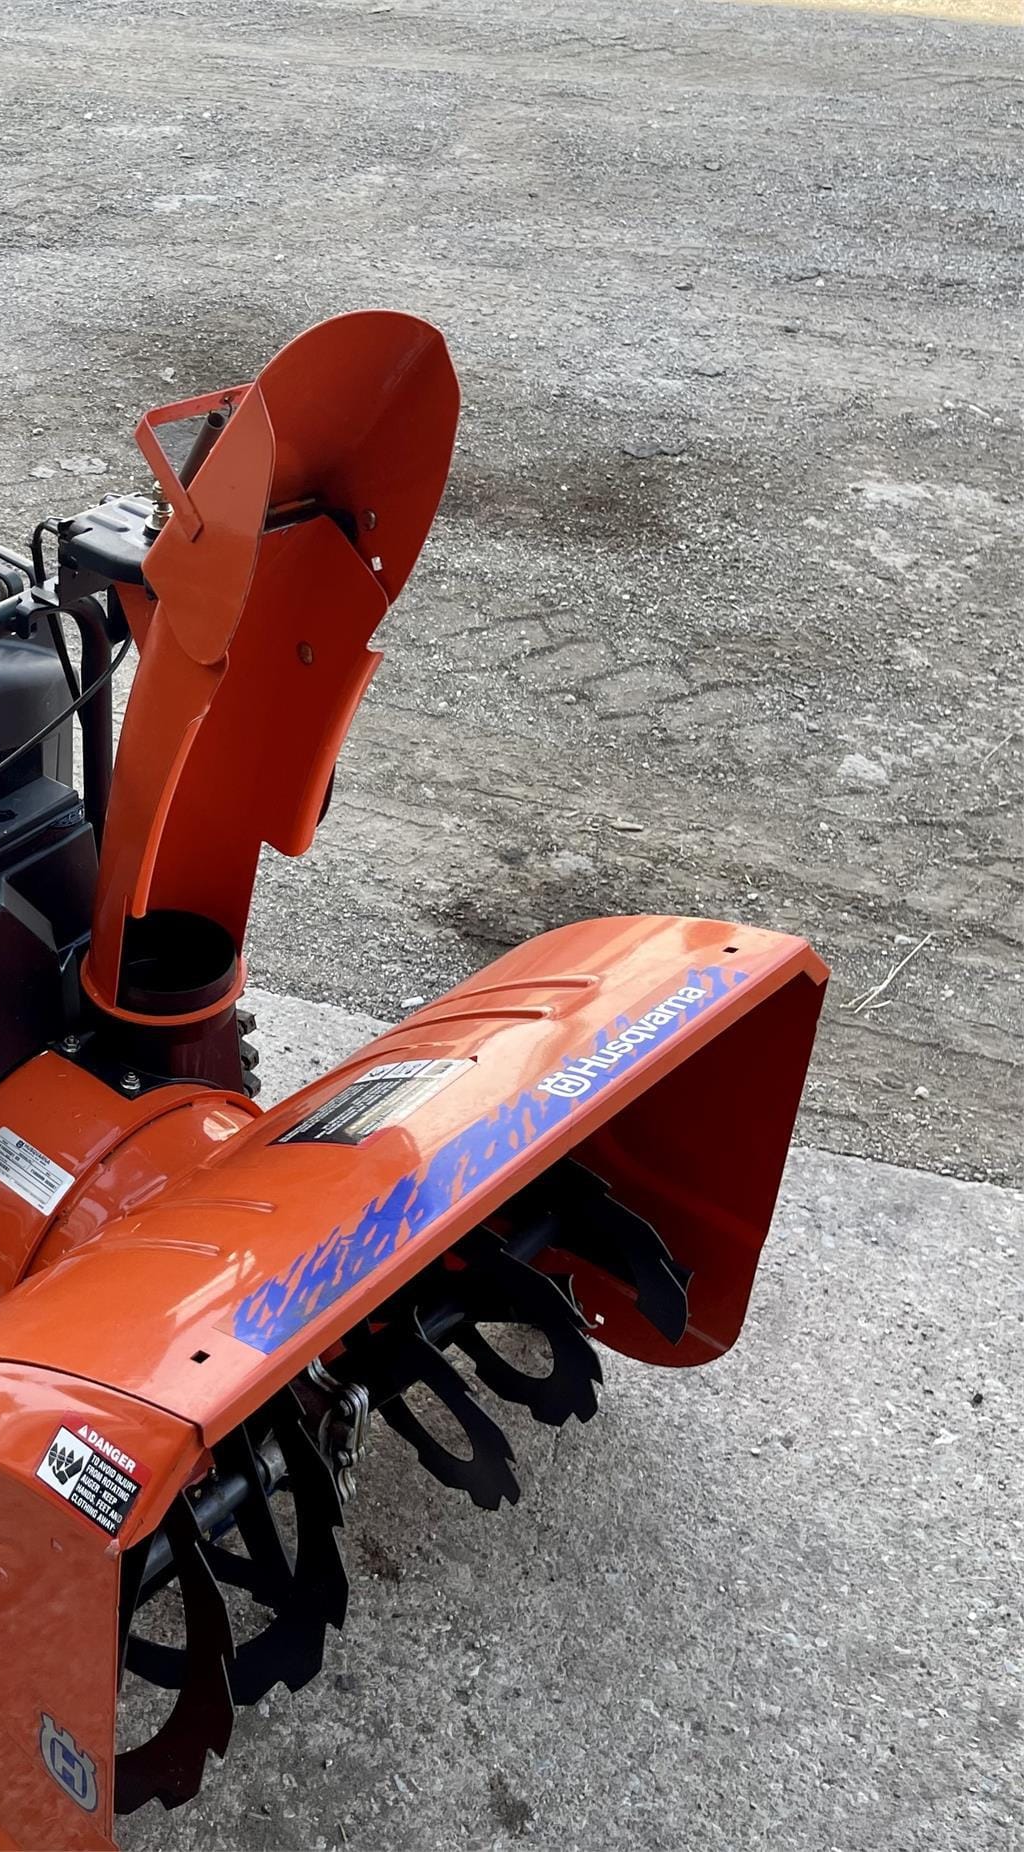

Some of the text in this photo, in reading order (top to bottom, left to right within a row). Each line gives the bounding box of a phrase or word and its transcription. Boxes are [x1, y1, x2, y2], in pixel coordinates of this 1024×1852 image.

[567, 986, 707, 1078] Husqvarna
[87, 1430, 136, 1473] DANGER
[81, 1475, 100, 1493] AUGER
[102, 1490, 117, 1505] KEEP
[86, 1464, 129, 1502] FROM ROTATING
[91, 1455, 137, 1493] TO AVOID INJURY
[71, 1494, 97, 1518] CLOTHING
[96, 1498, 111, 1513] FEET
[110, 1508, 122, 1523] AND
